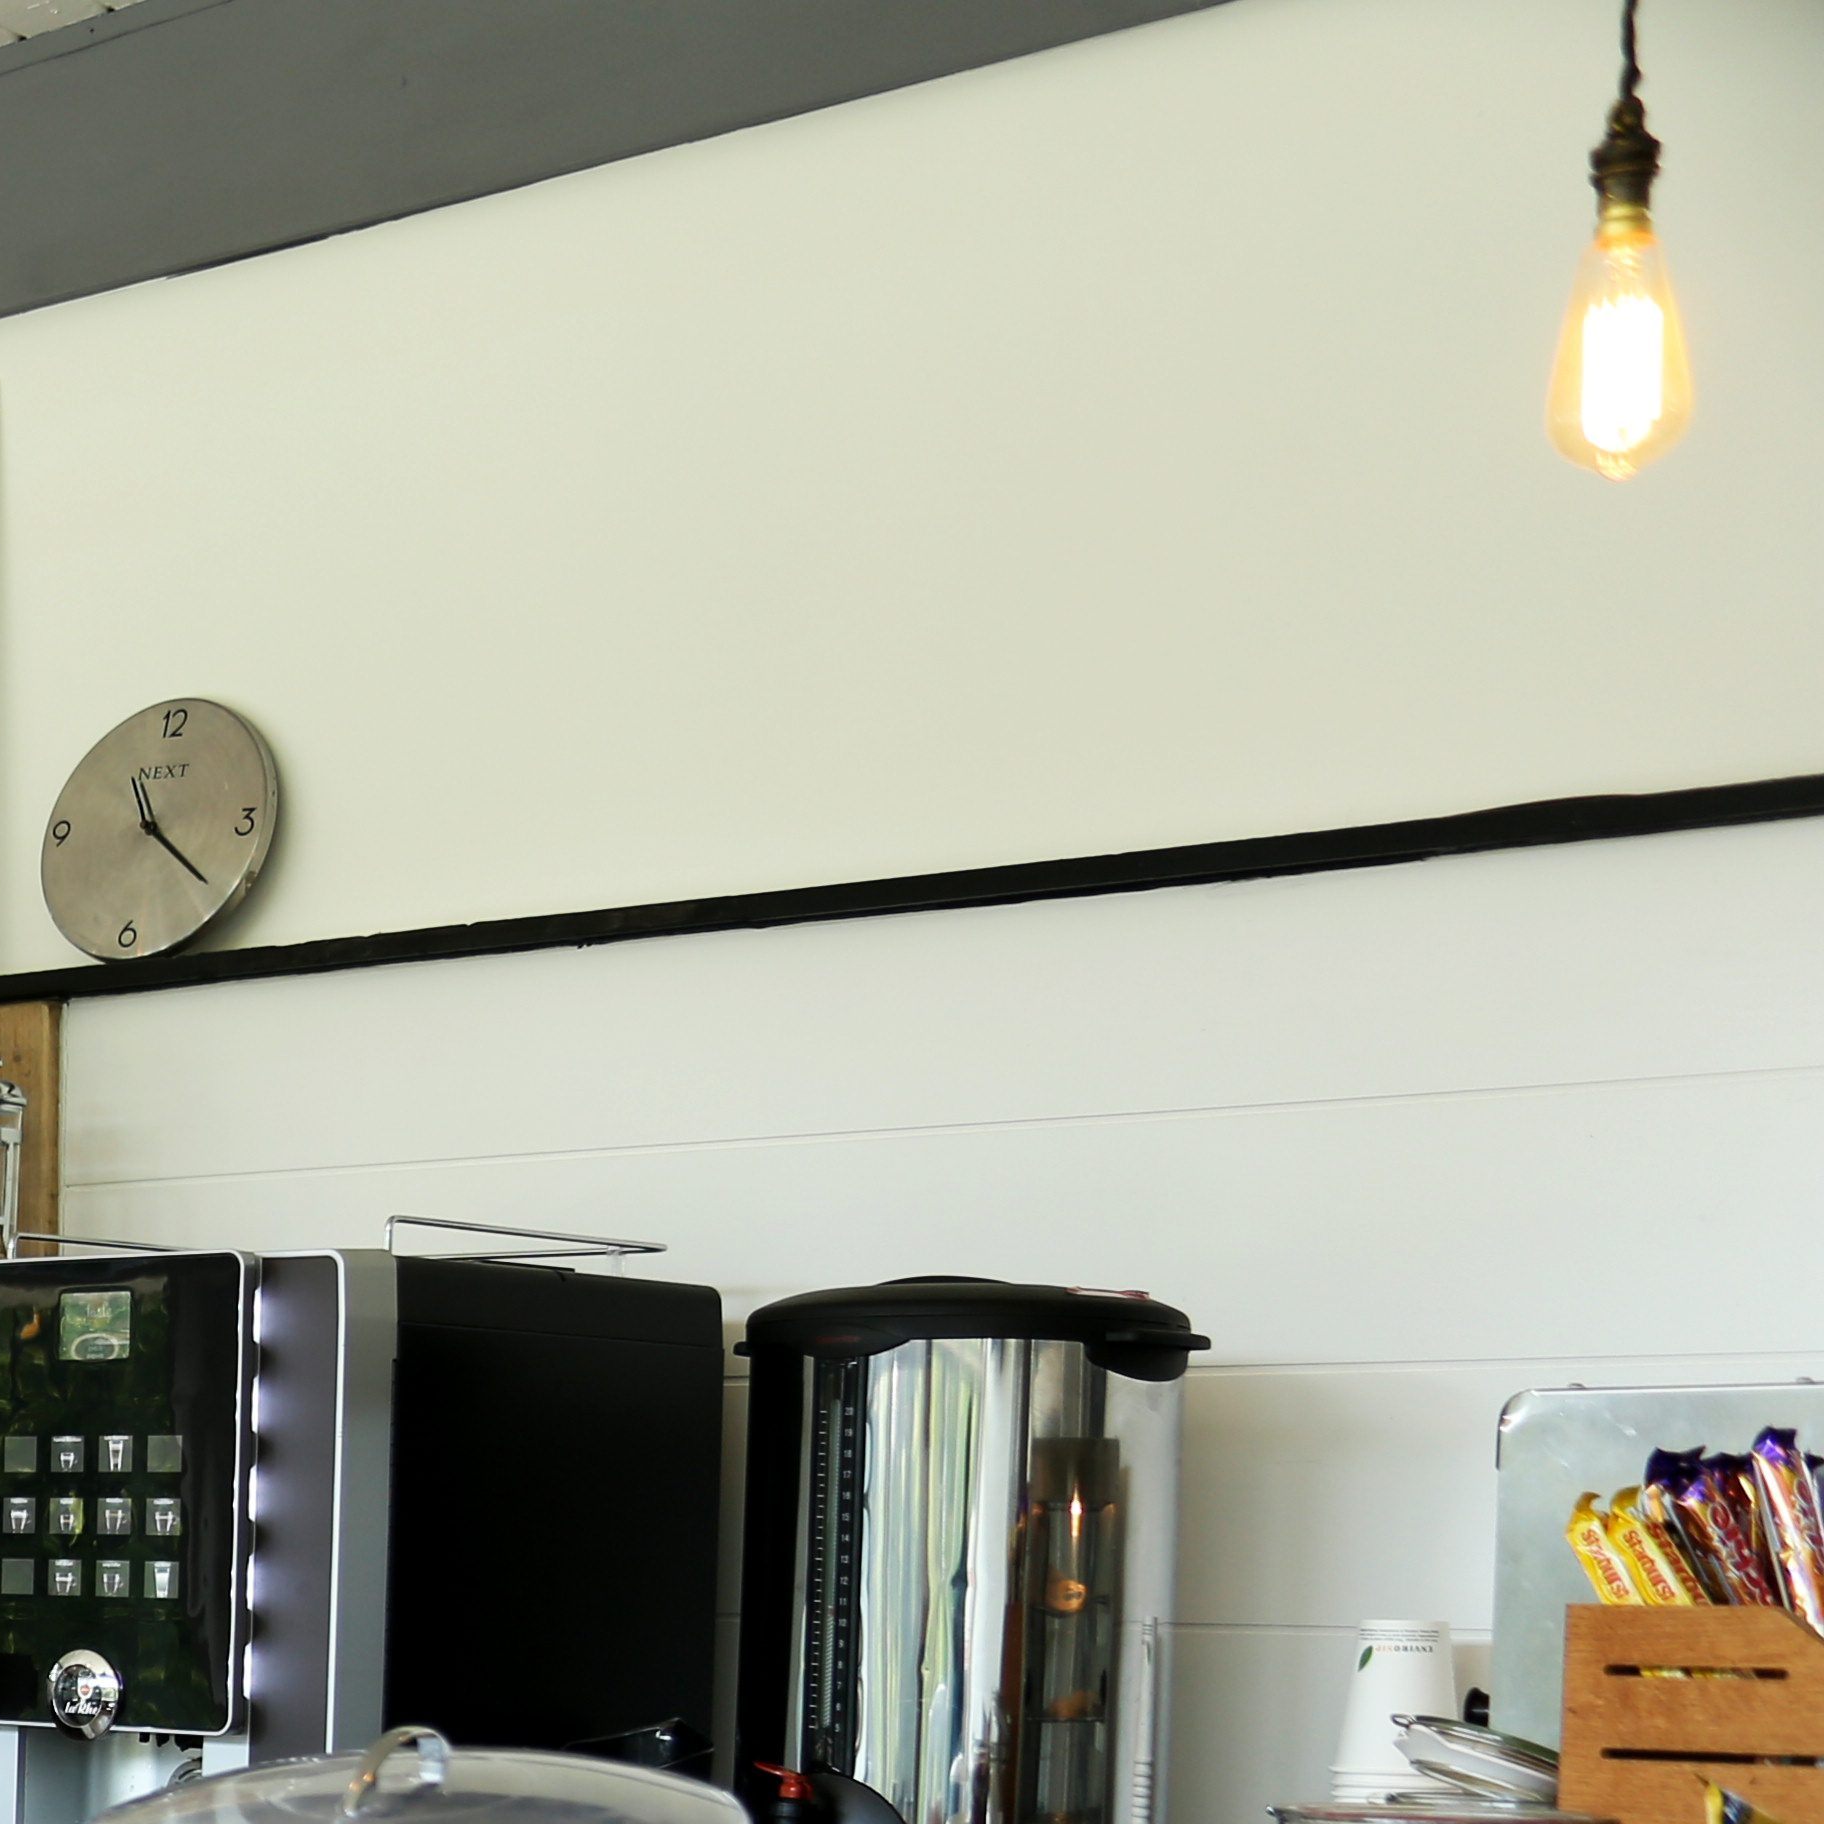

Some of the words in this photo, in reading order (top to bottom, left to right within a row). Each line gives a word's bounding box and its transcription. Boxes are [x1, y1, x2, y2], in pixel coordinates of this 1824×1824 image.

[162, 709, 188, 738] 12
[138, 763, 190, 781] NEXT
[234, 807, 257, 836] 3
[52, 820, 71, 847] 9
[118, 920, 137, 948] 6
[844, 1407, 854, 1415] 20
[844, 1428, 853, 1437] 19
[843, 1449, 852, 1458] 18
[843, 1471, 851, 1479] 17
[842, 1492, 851, 1500] 16
[841, 1513, 850, 1521] 15
[841, 1534, 850, 1542] 14
[840, 1555, 849, 1563] 13
[1580, 1527, 1630, 1600] Starburst
[1622, 1529, 1676, 1601] Starburst
[840, 1576, 849, 1585] 12
[838, 1618, 847, 1627] 10
